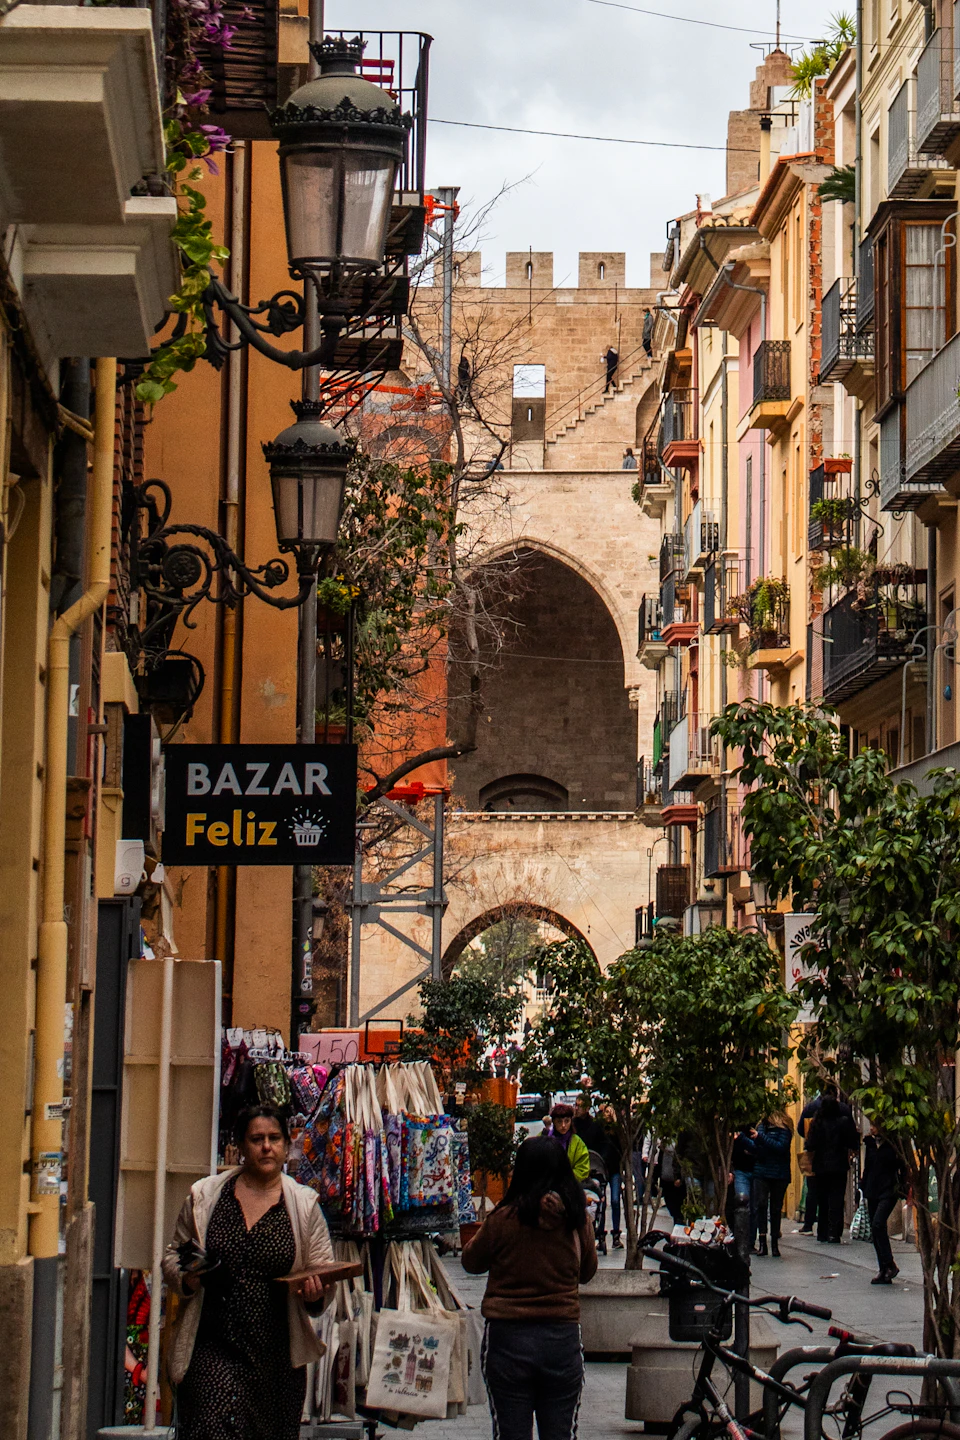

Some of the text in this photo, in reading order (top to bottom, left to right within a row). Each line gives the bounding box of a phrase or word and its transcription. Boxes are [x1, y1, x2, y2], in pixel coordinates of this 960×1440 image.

[187, 762, 332, 796] BAZAR
[185, 809, 278, 846] Feliz
[789, 924, 811, 949] Vaya
[311, 1038, 359, 1065] 1.50
